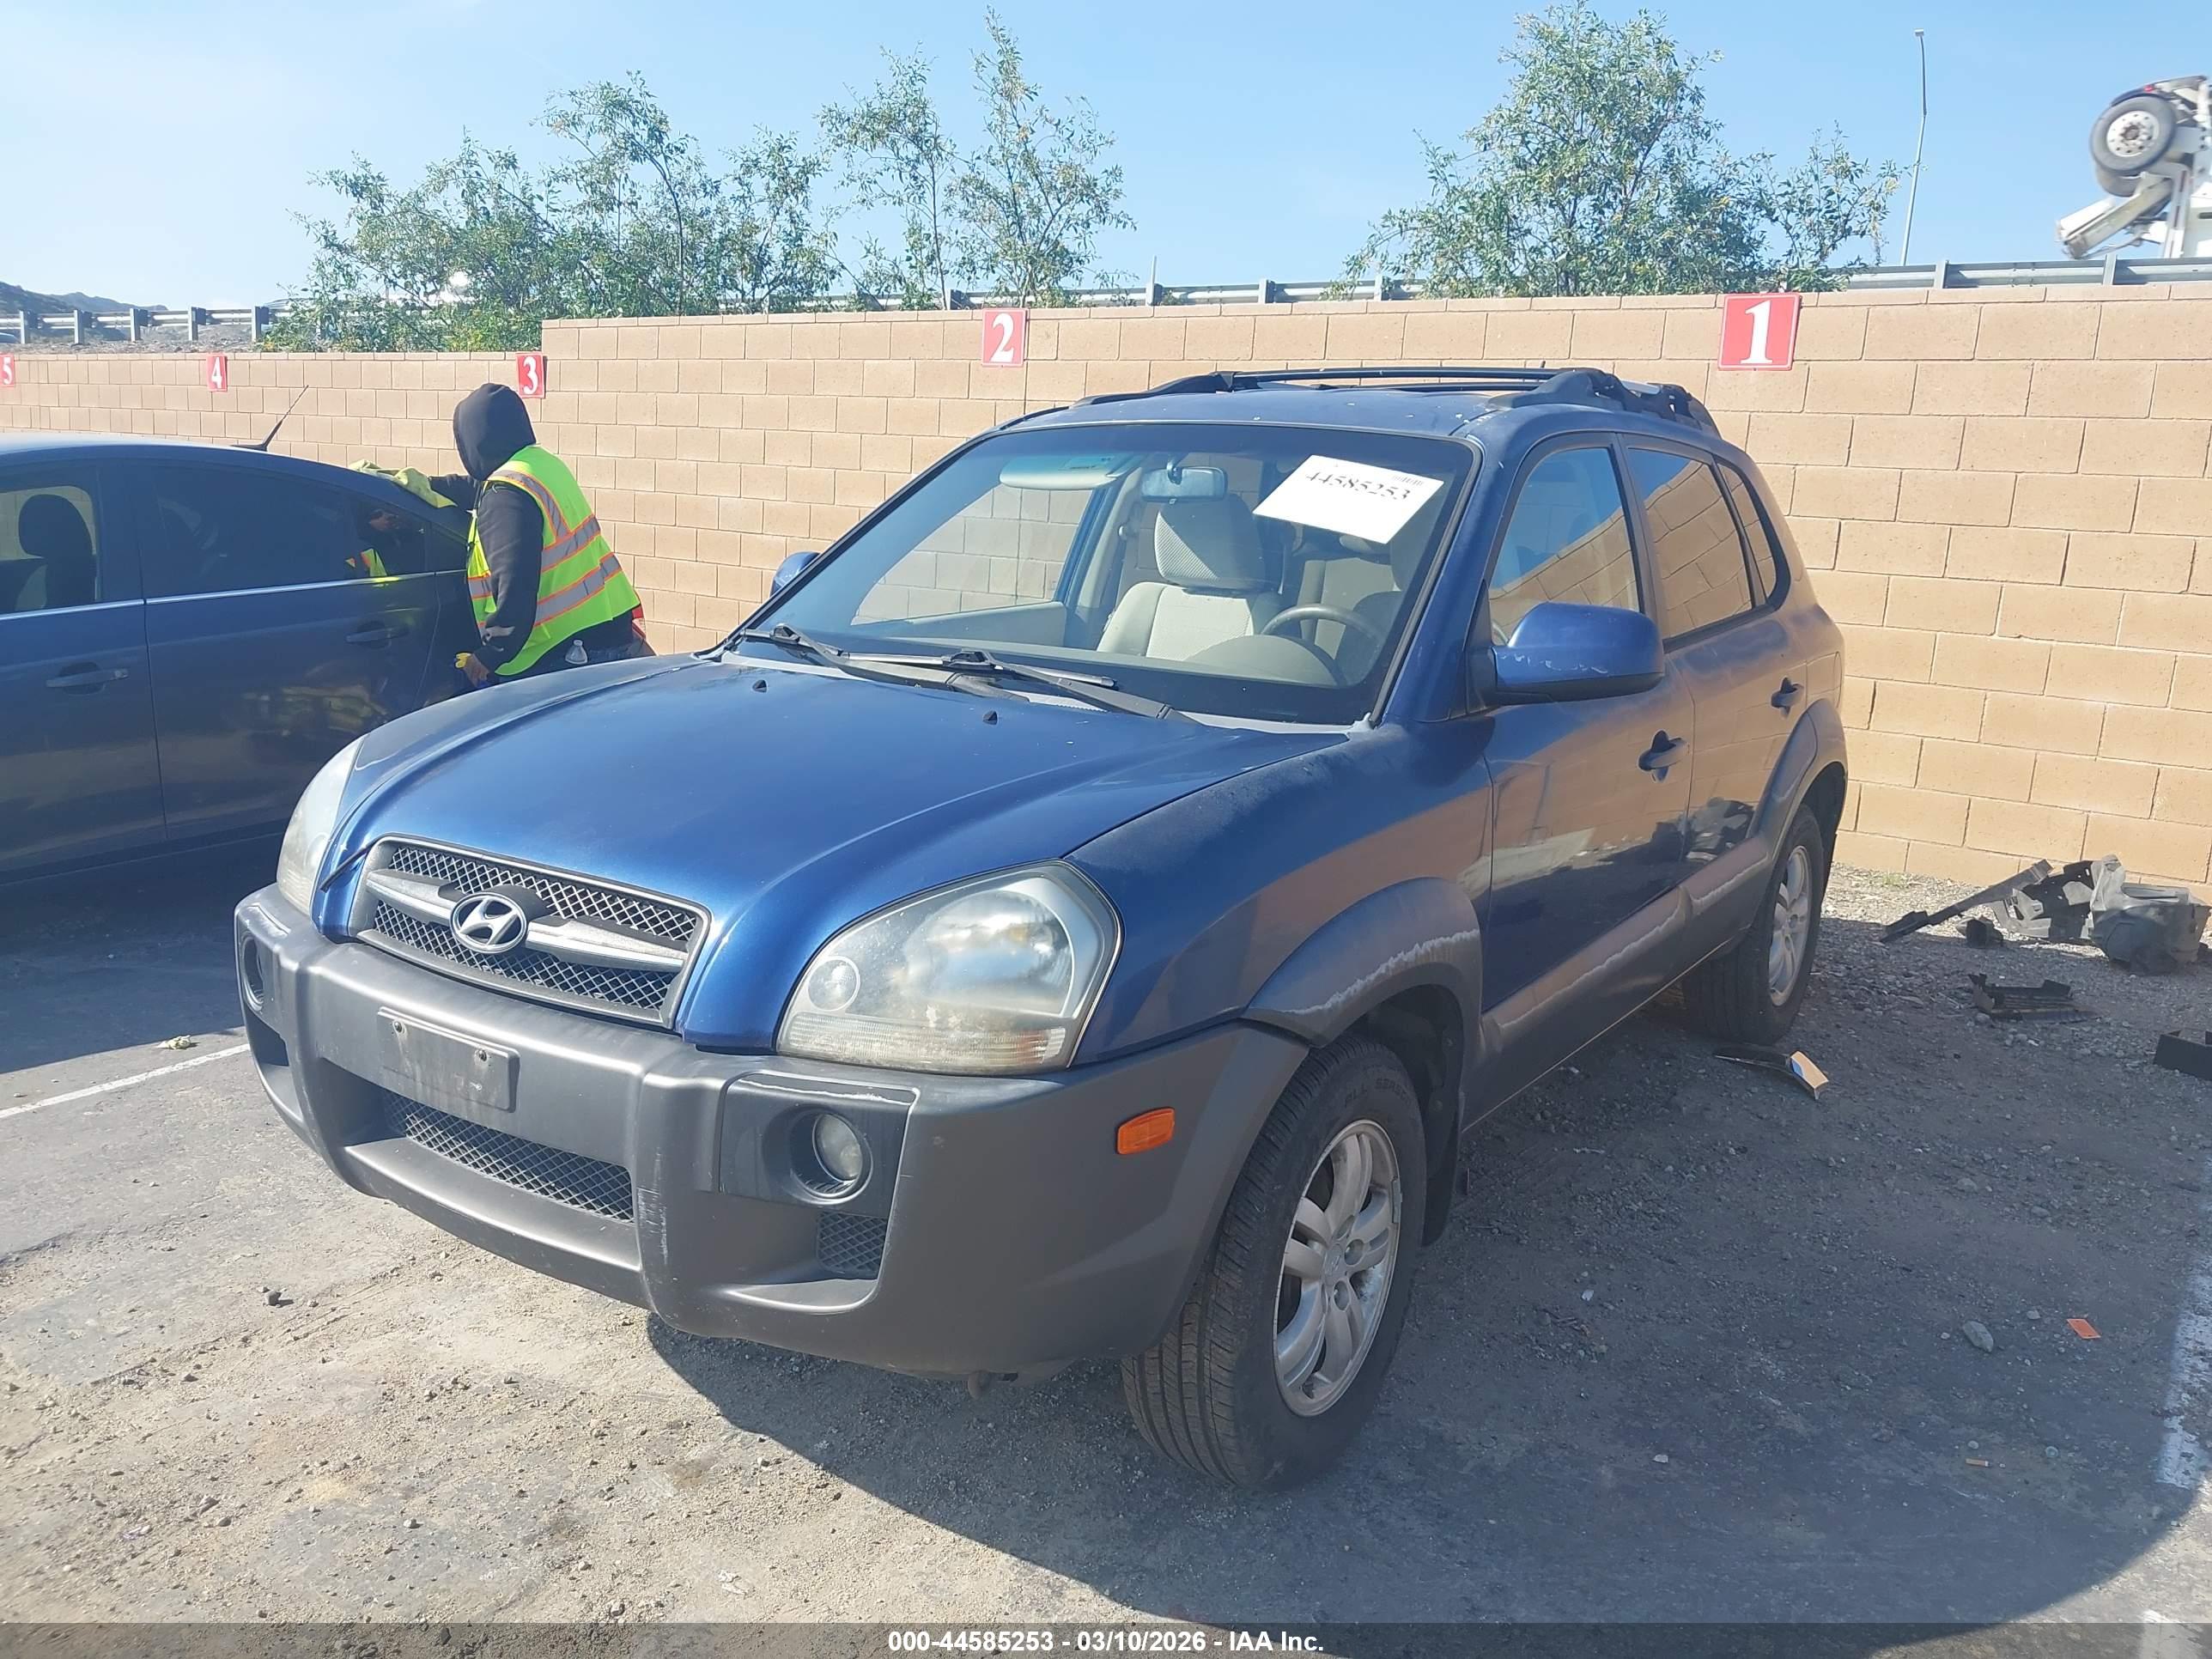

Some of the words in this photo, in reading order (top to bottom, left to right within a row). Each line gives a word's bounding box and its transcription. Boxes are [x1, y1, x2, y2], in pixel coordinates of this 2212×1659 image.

[990, 313, 1014, 362] 2
[1740, 299, 1773, 364] 1
[3, 356, 12, 385] 5
[211, 356, 222, 389] 4
[523, 356, 538, 395] 3
[1305, 471, 1411, 500] 44585253
